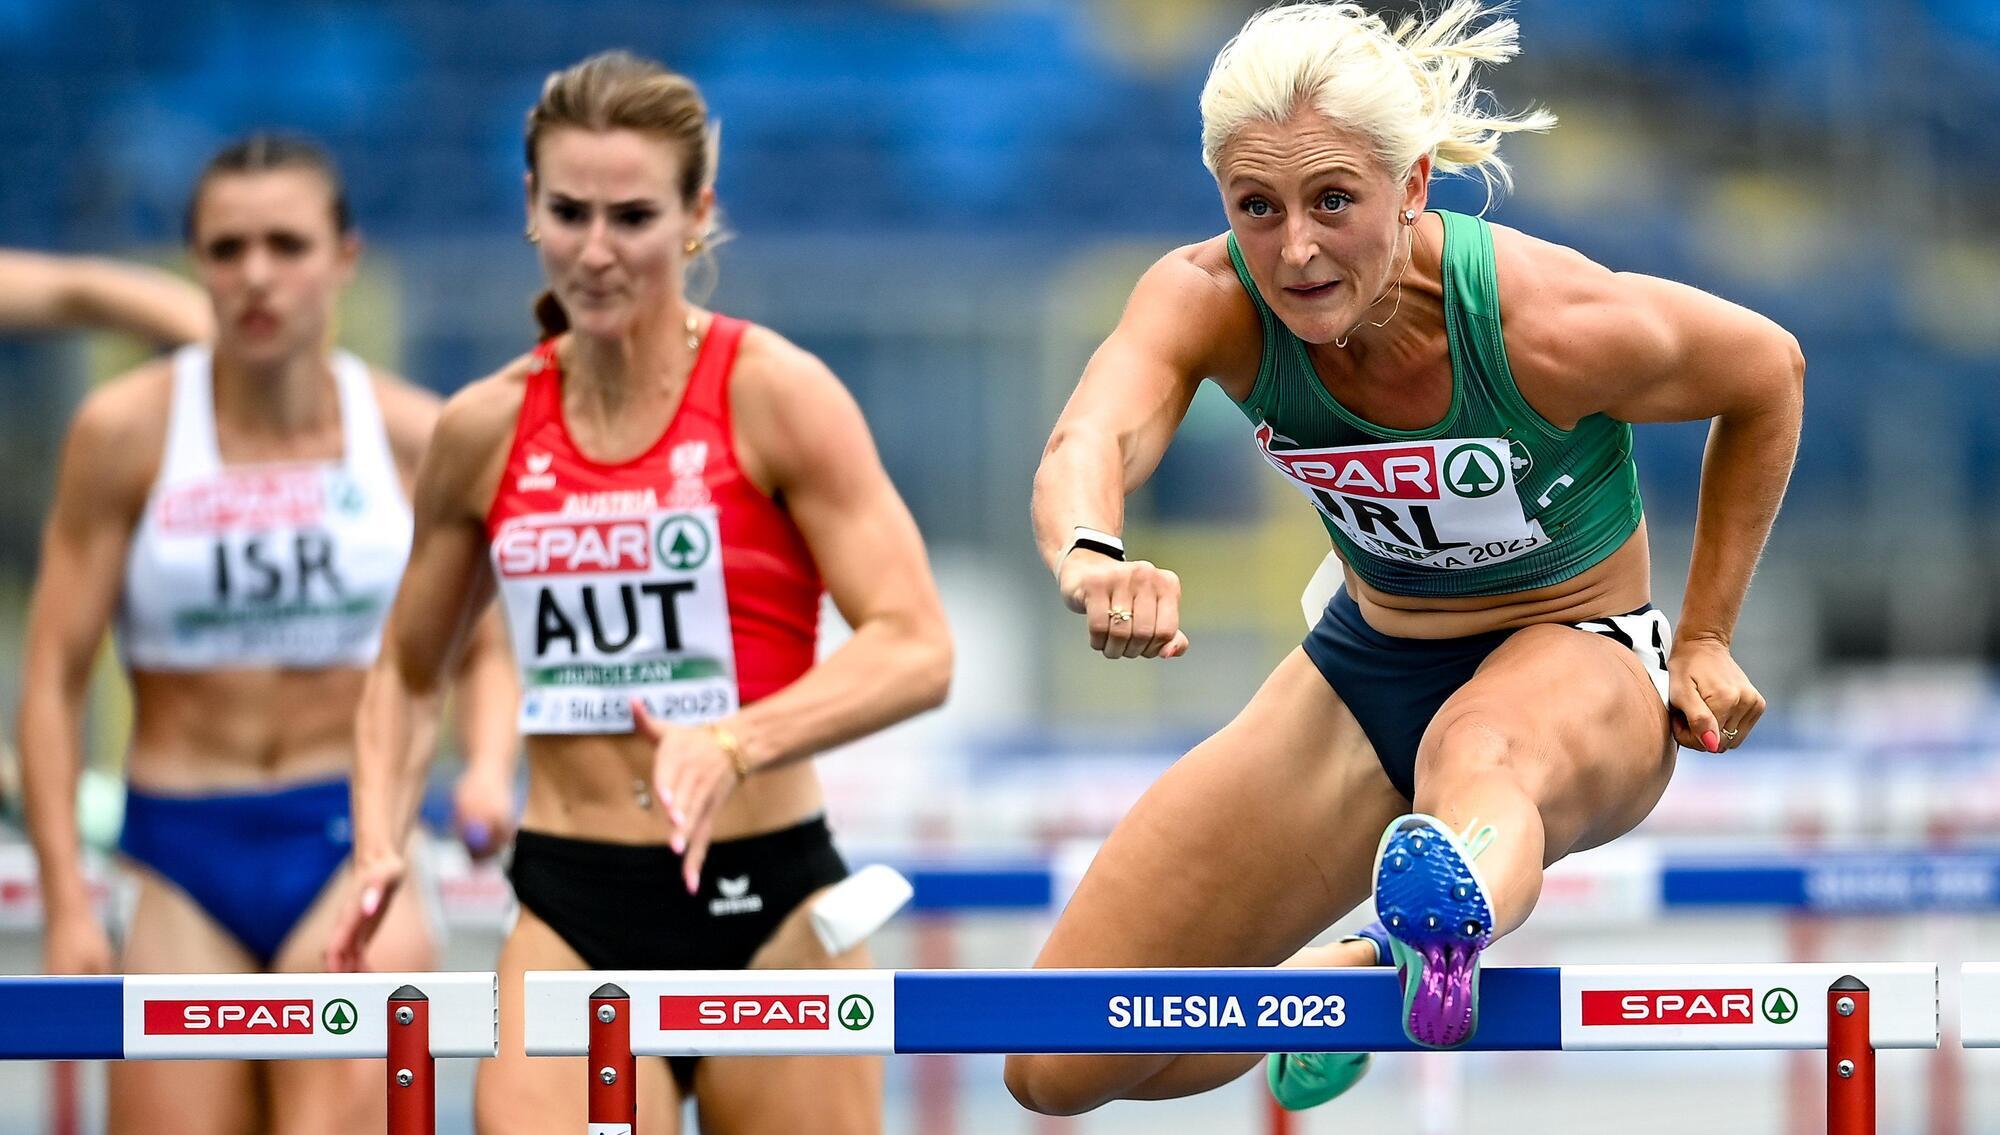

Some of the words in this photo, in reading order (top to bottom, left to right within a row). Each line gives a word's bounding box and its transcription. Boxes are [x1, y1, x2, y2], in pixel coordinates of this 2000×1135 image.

[1311, 486, 1471, 550] IRL
[213, 530, 346, 604] ISR
[502, 522, 650, 574] SPAR
[536, 580, 695, 656] AUT
[184, 1005, 311, 1029] SPAR
[698, 1000, 827, 1025] SPAR
[1108, 995, 1247, 1028] SILESIA
[1257, 995, 1346, 1028] 2023
[1621, 994, 1751, 1019] SPAR
